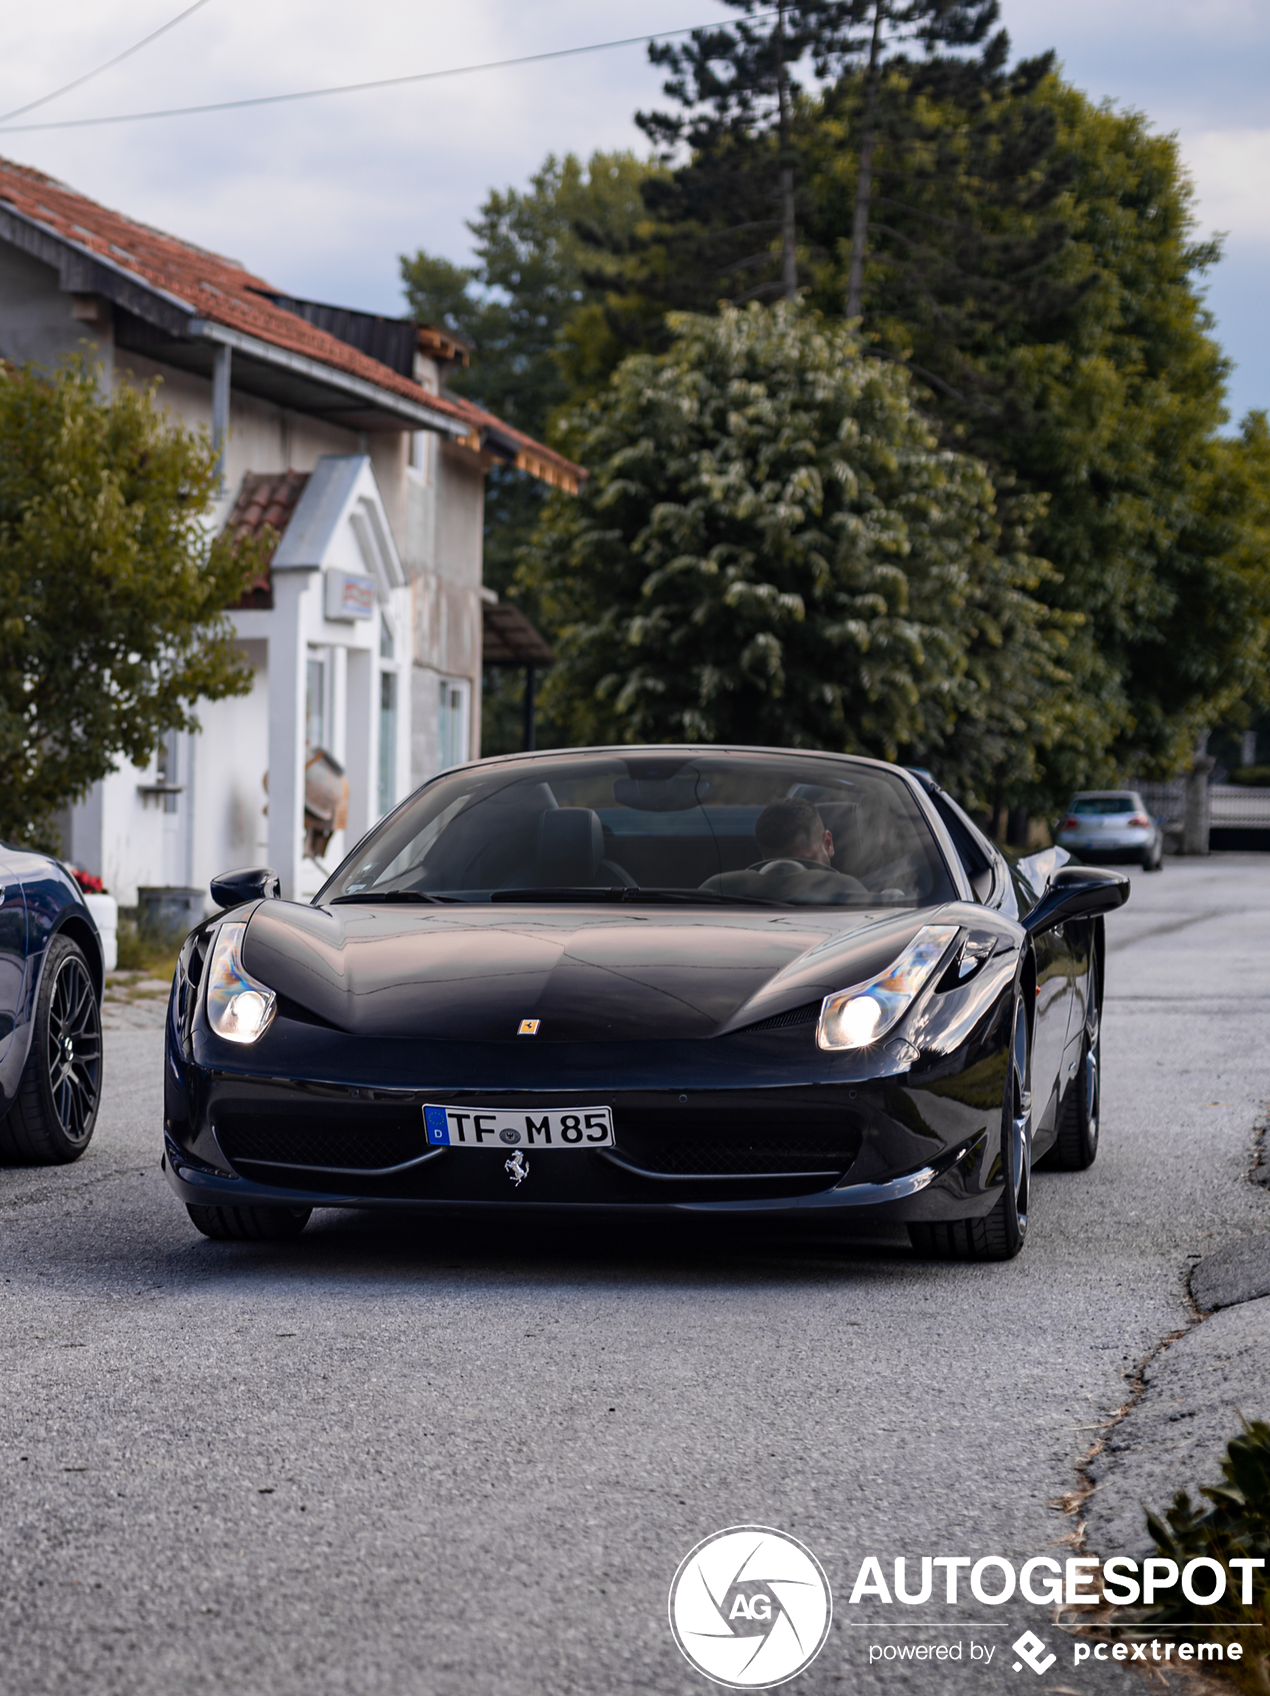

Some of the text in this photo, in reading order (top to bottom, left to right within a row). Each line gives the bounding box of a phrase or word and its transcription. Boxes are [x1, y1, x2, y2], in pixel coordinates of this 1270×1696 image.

[434, 1129, 443, 1138] D
[447, 1113, 609, 1143] TF M 85
